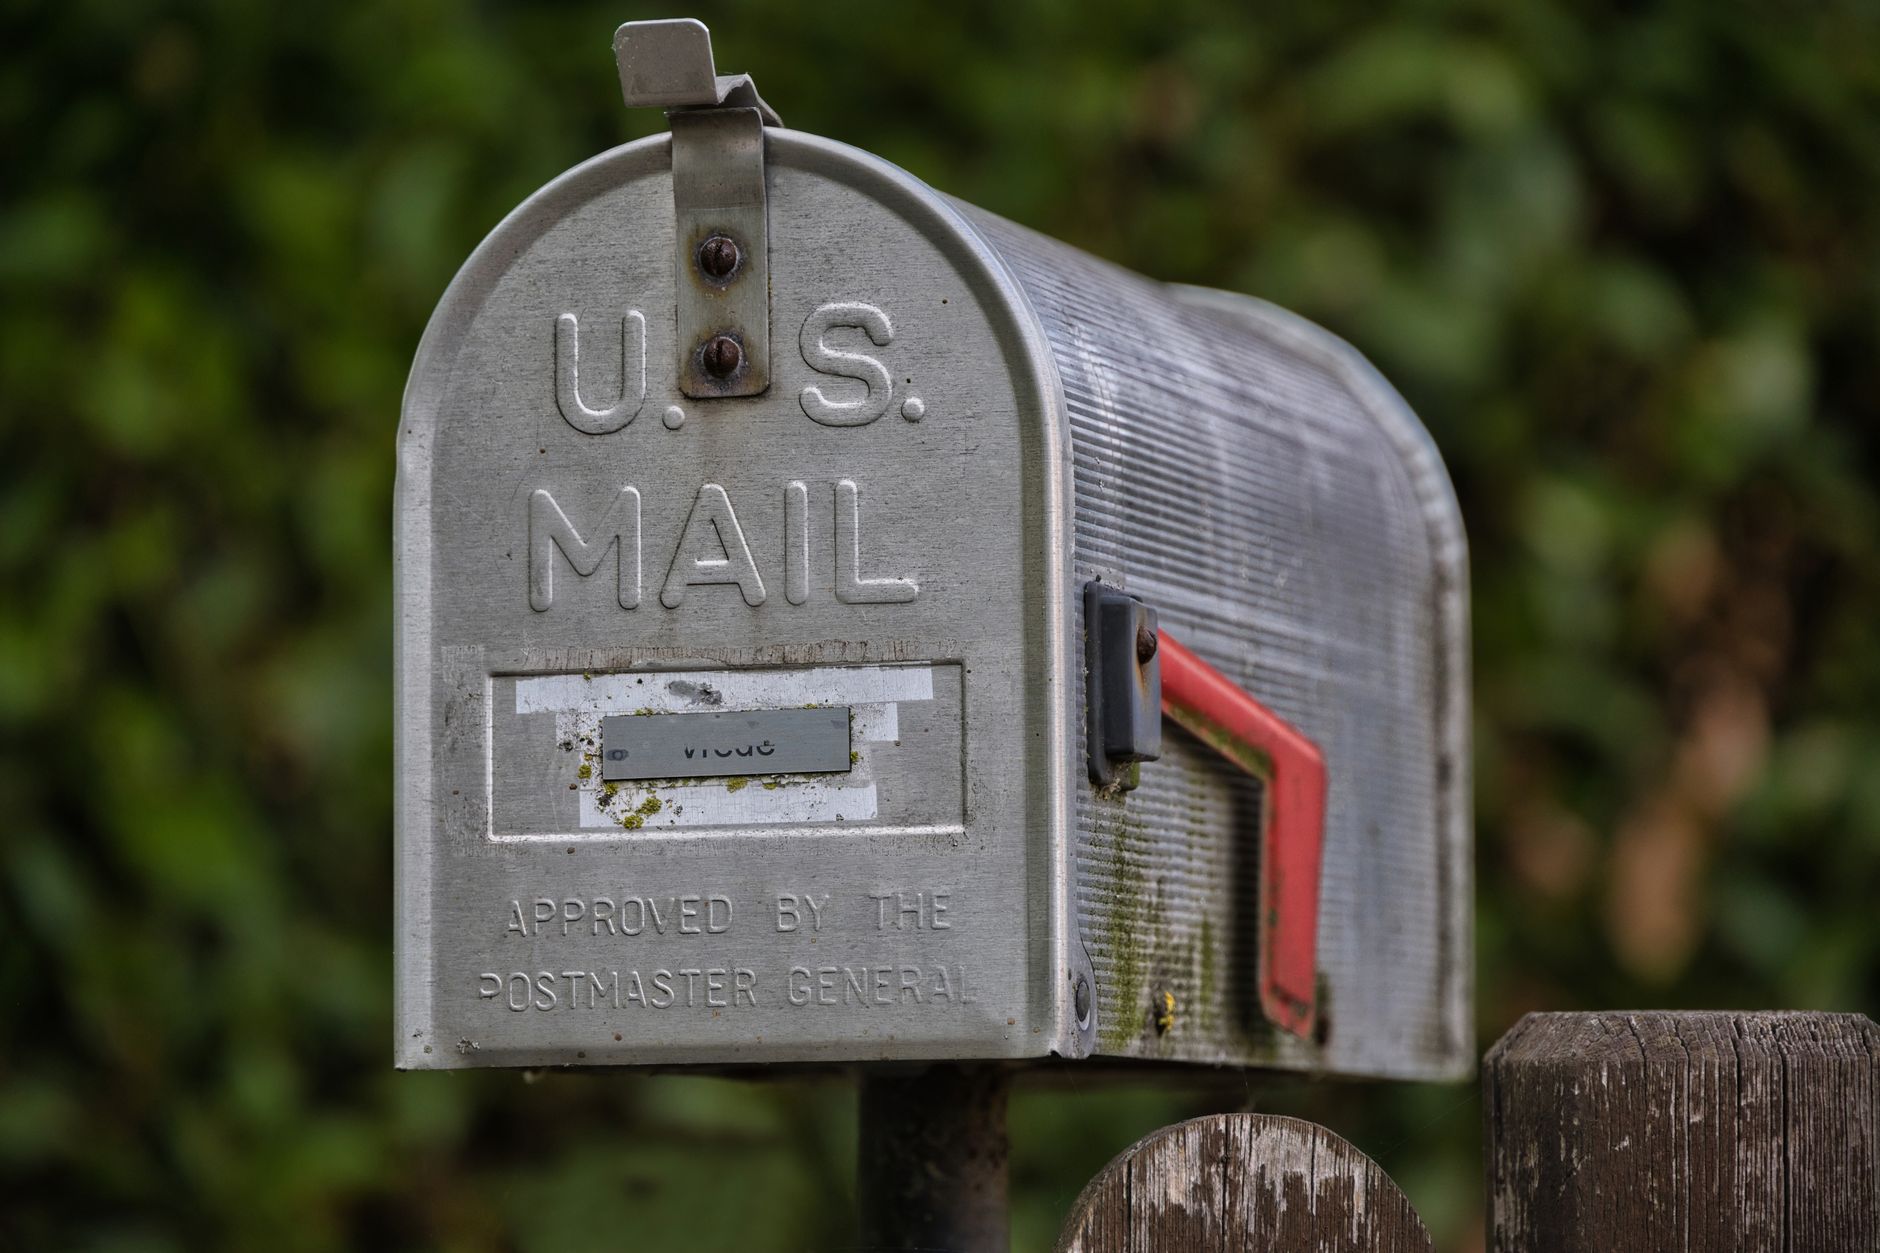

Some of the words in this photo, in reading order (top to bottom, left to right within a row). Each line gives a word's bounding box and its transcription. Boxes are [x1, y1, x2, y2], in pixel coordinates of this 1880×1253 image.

[528, 479, 919, 612] MAIL
[503, 894, 733, 937] APPROVED
[776, 892, 830, 932] BY
[868, 892, 951, 930] THE
[479, 966, 757, 1012] POSTMASTER
[788, 965, 974, 1007] GENERAL
